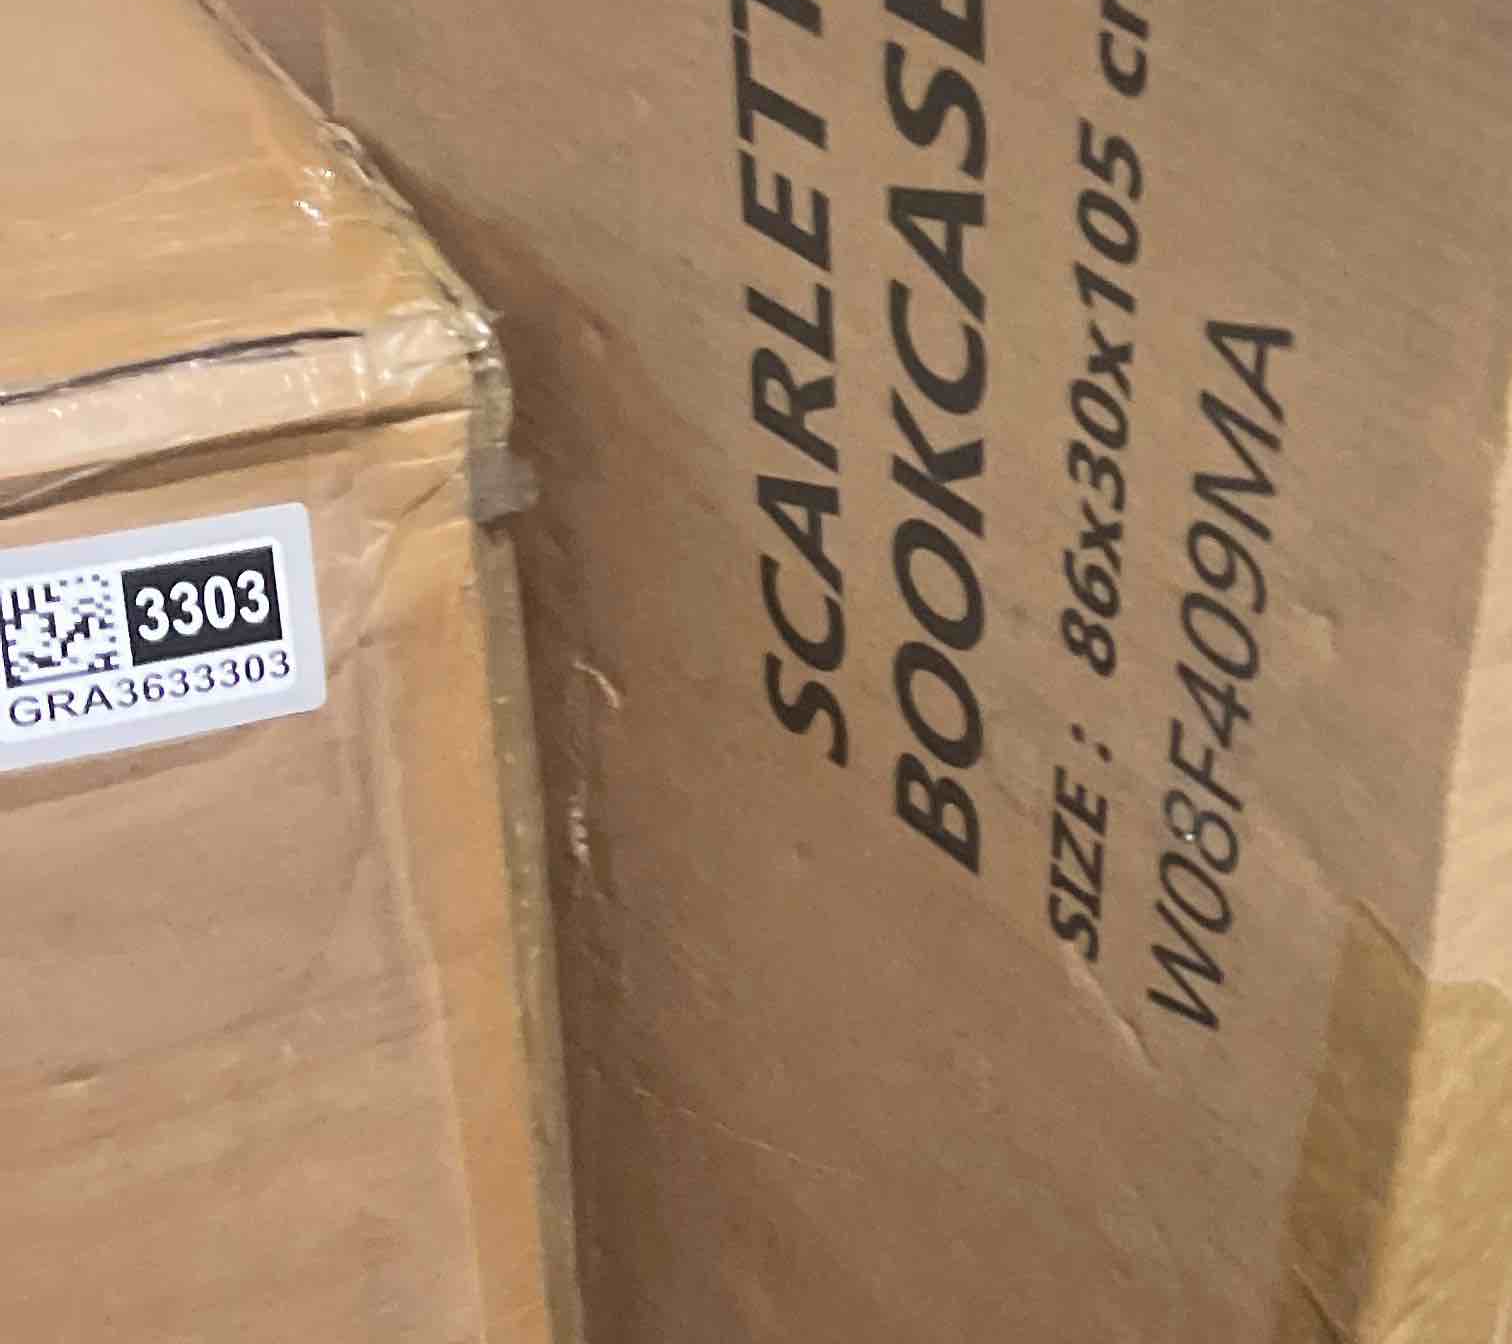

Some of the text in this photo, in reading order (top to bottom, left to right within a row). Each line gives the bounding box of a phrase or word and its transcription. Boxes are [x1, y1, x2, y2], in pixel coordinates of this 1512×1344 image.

[1060, 116, 1144, 679] 86x30x105
[9, 649, 291, 727] GRA3633303
[135, 569, 271, 642] 3303
[1147, 319, 1295, 1032] W08F409MA
